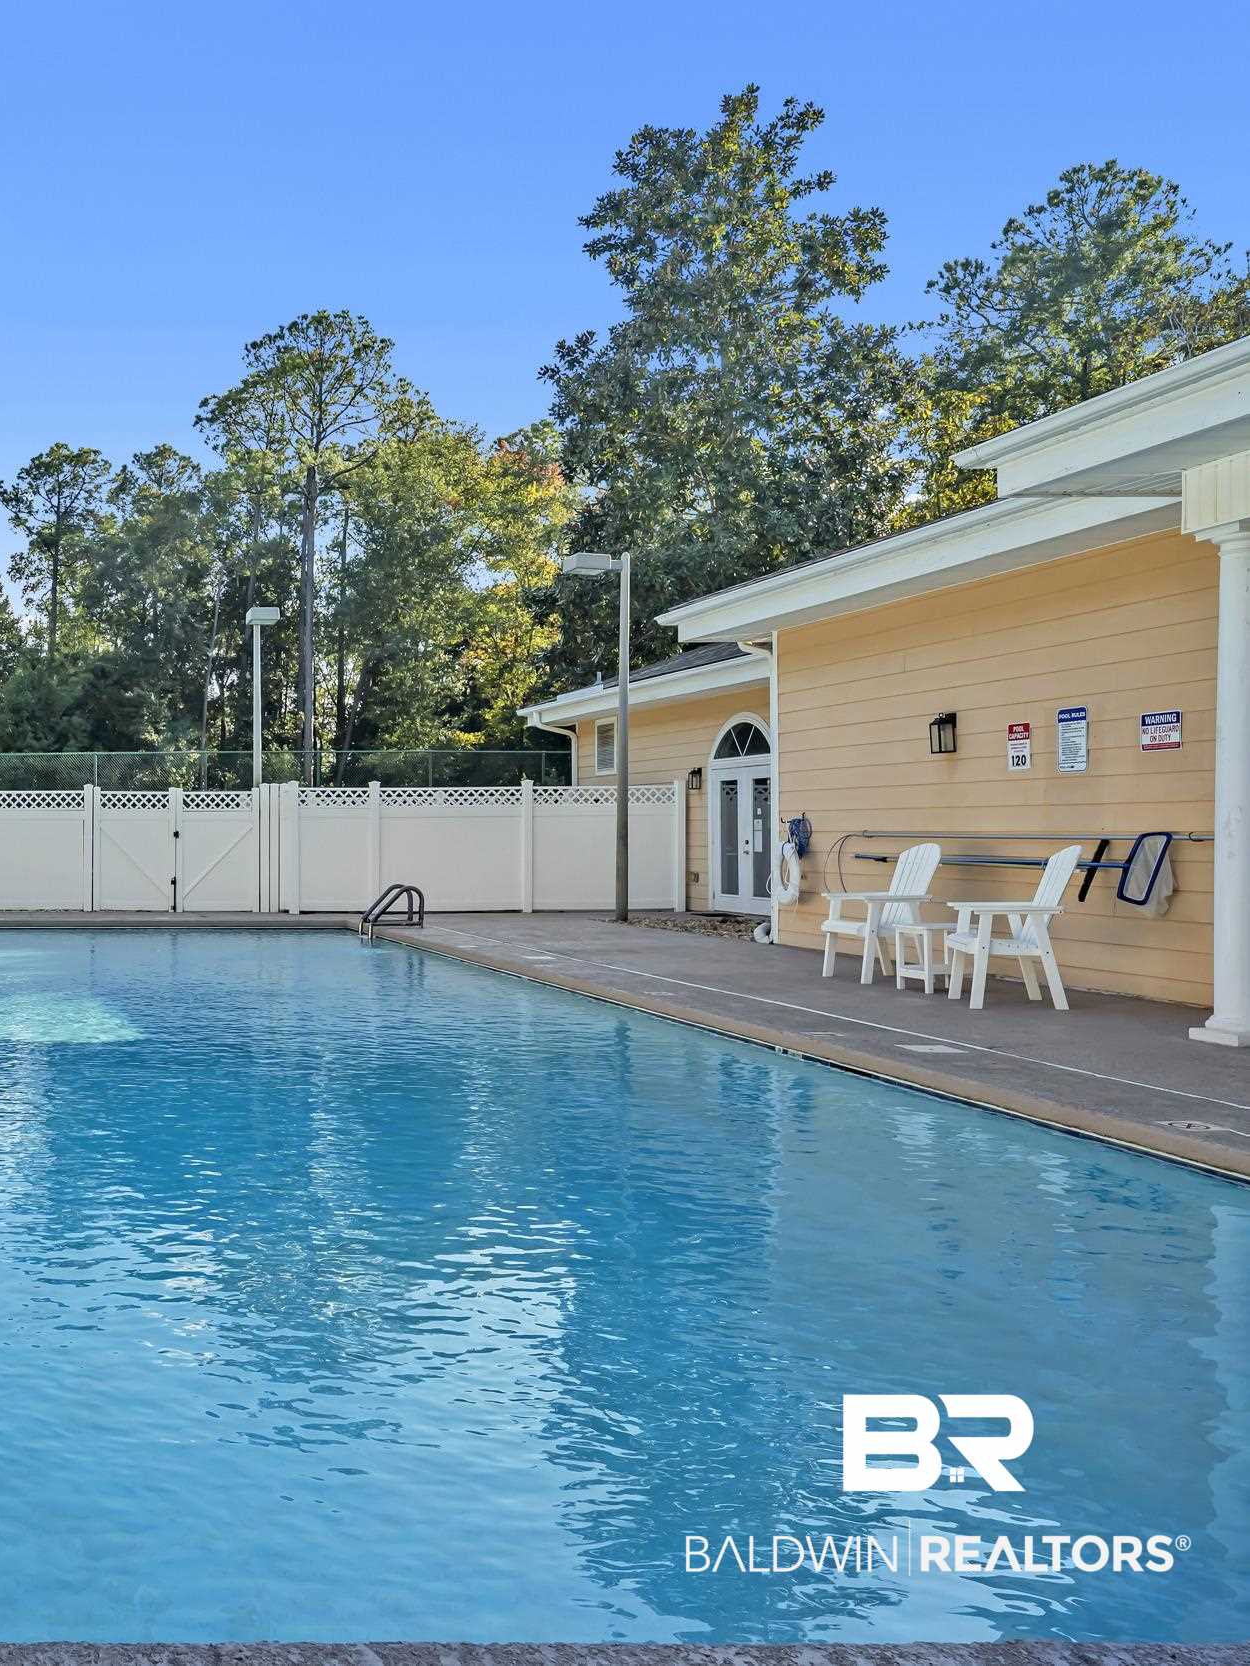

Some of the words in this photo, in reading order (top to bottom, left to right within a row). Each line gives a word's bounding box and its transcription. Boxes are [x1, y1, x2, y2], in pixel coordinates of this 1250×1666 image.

[1144, 713, 1177, 724] WARNING
[1142, 727, 1149, 735] NO
[1150, 724, 1180, 734] LIFEGUARD
[1150, 735, 1157, 743] ON
[1158, 734, 1170, 742] DUTY
[1011, 754, 1027, 767] 120
